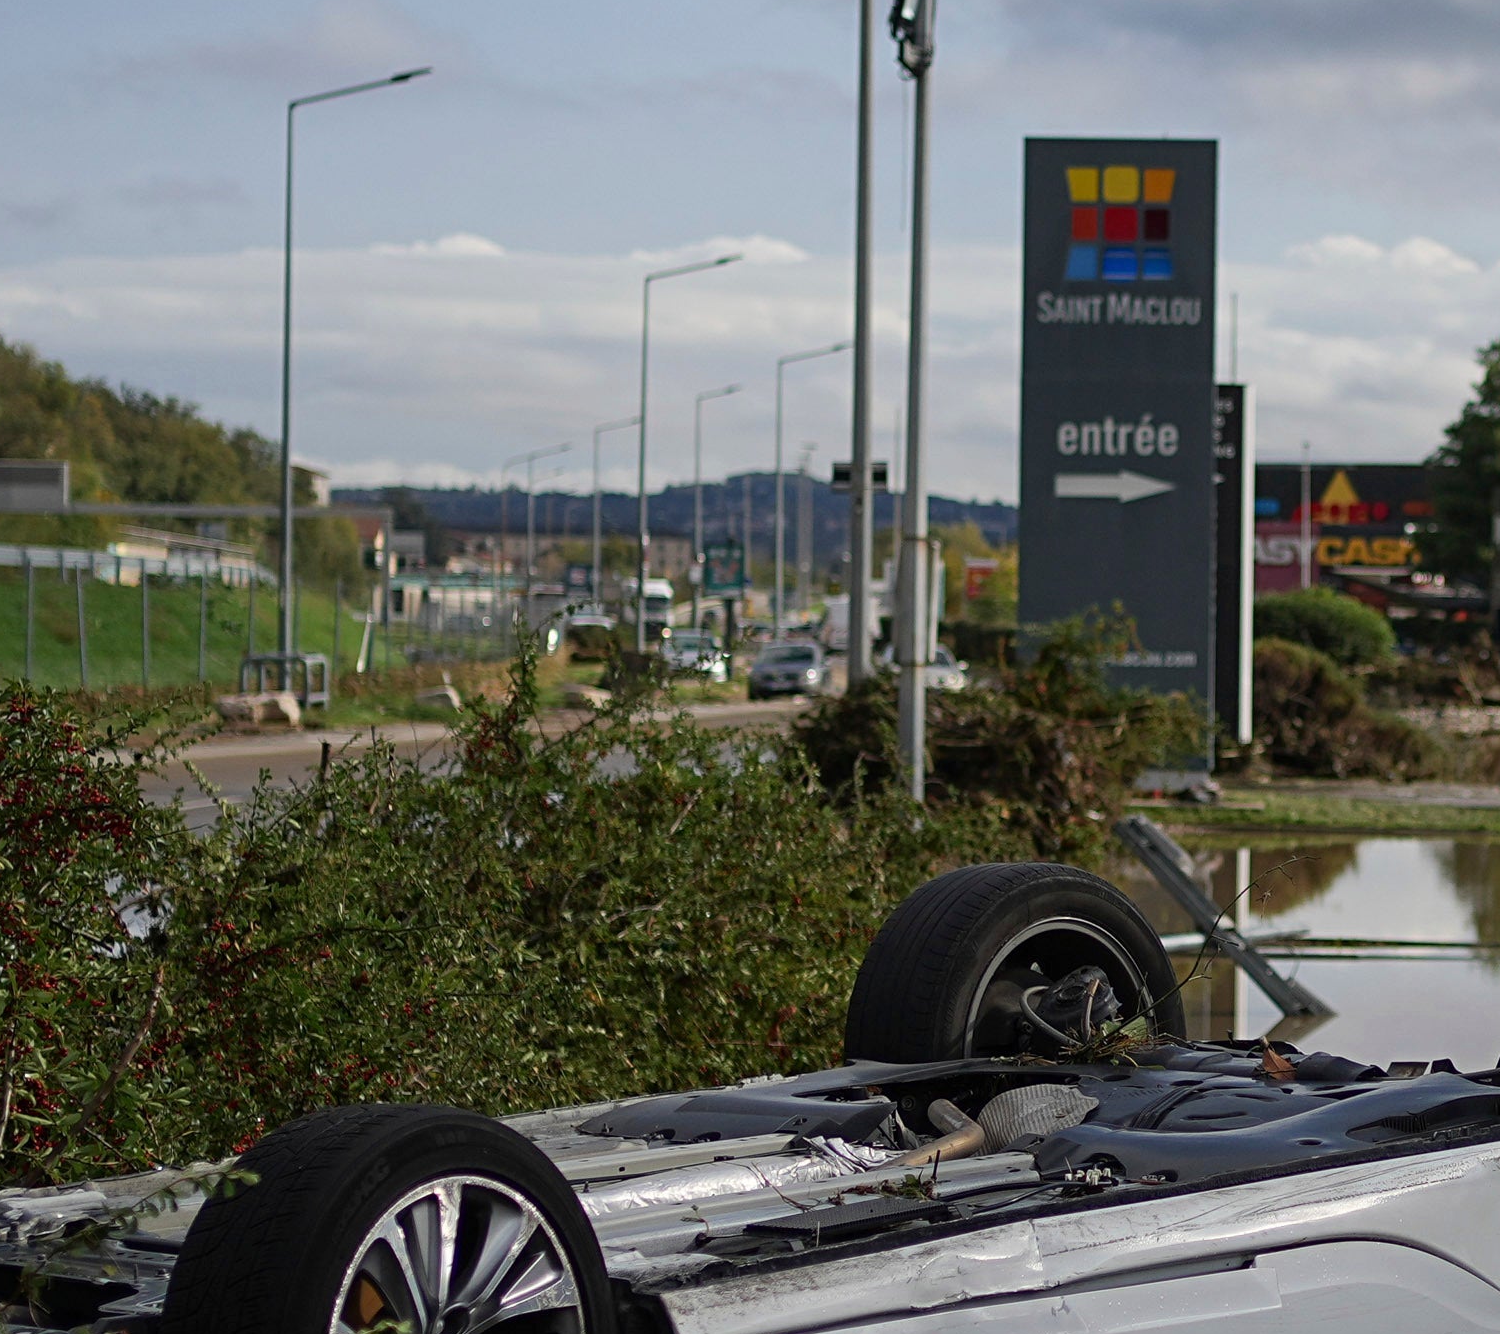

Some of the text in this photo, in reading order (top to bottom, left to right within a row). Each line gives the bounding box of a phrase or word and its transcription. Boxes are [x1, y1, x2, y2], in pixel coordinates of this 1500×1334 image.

[1037, 291, 1201, 324] SAINT MACLOU
[1057, 414, 1179, 456] entrée
